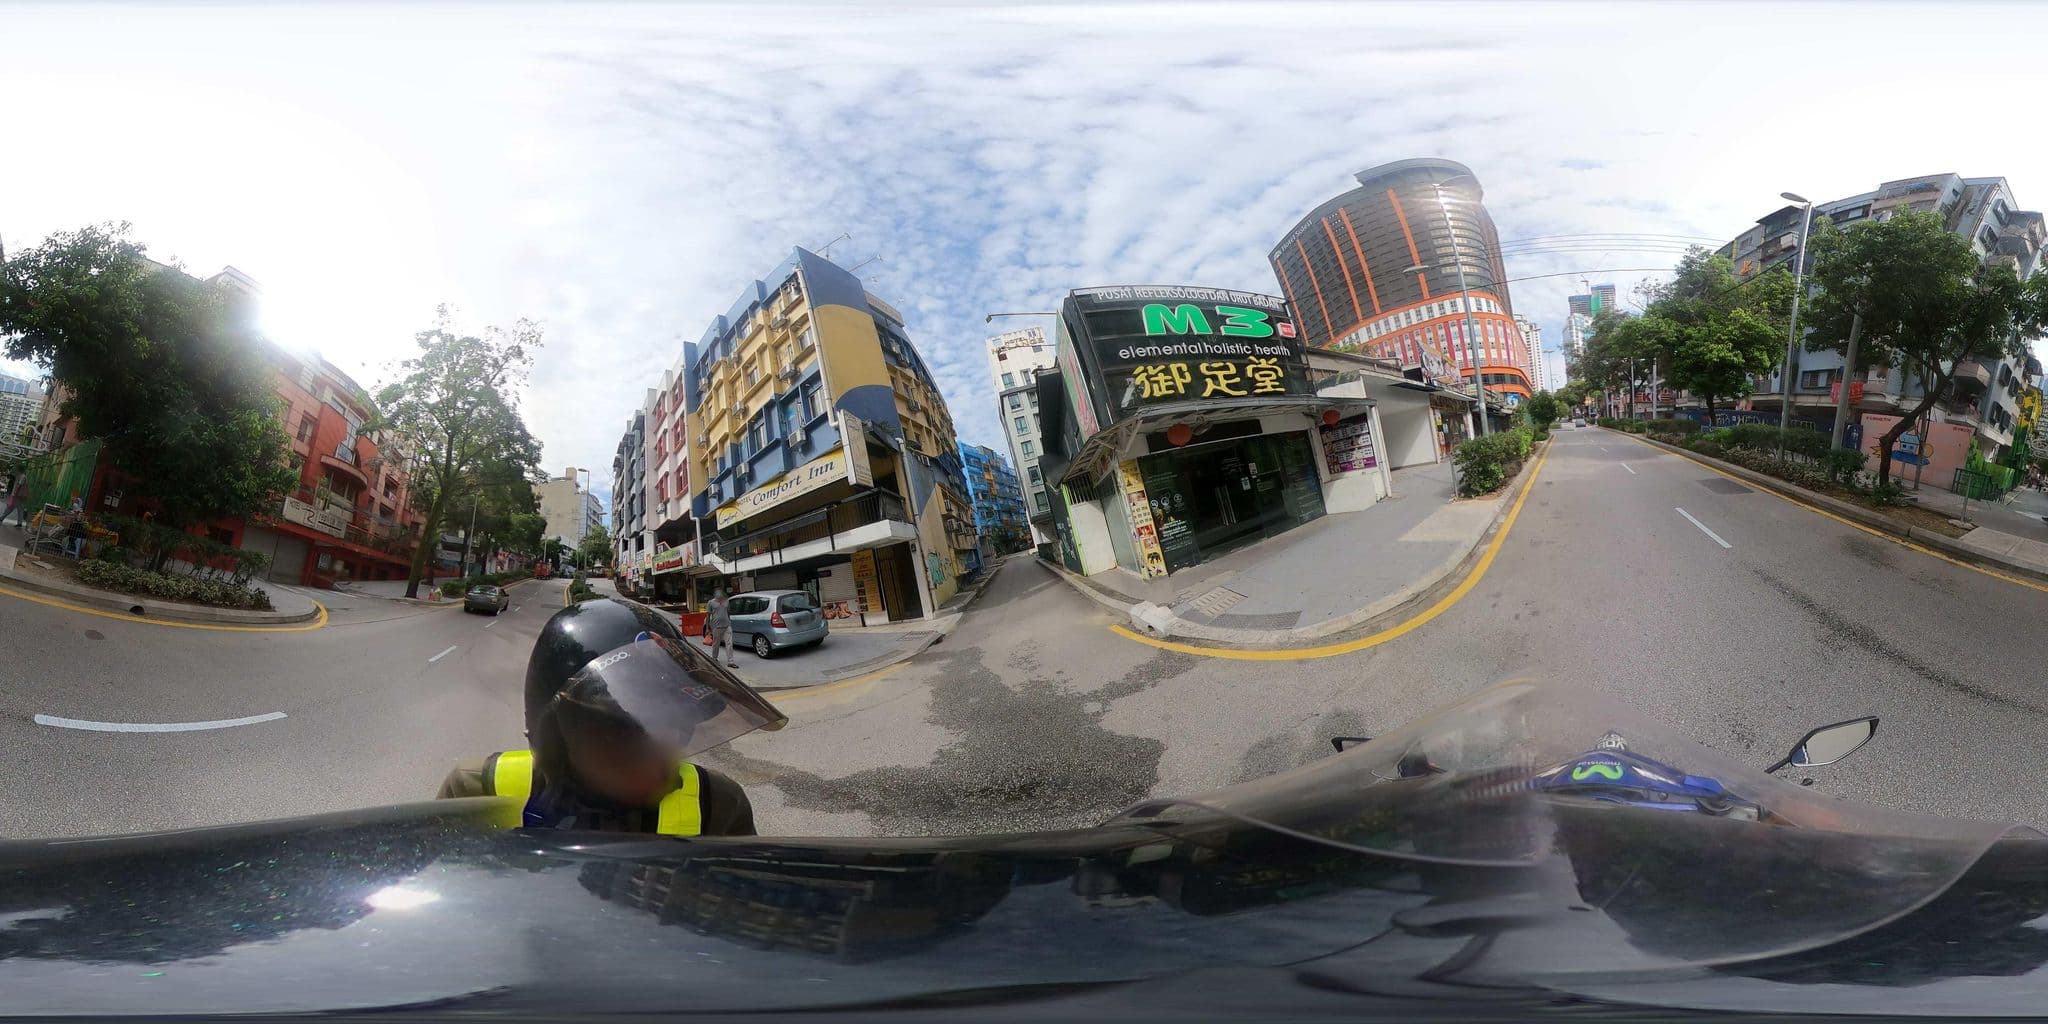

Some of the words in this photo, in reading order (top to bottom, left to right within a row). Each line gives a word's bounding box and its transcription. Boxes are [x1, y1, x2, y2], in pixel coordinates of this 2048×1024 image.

[1097, 288, 1132, 300] PUSAT
[1136, 287, 1210, 300] REFLEKSOLOGI
[1210, 289, 1229, 302] DAN
[1231, 290, 1253, 305] URUT
[1253, 294, 1280, 309] BADAN
[1142, 303, 1274, 338] M3
[1119, 343, 1202, 359] elemental
[1204, 342, 1252, 356] holistic
[1254, 343, 1291, 357] health
[1132, 356, 1286, 399] 御足堂
[753, 475, 802, 505] Comfort
[808, 462, 834, 480] Inn
